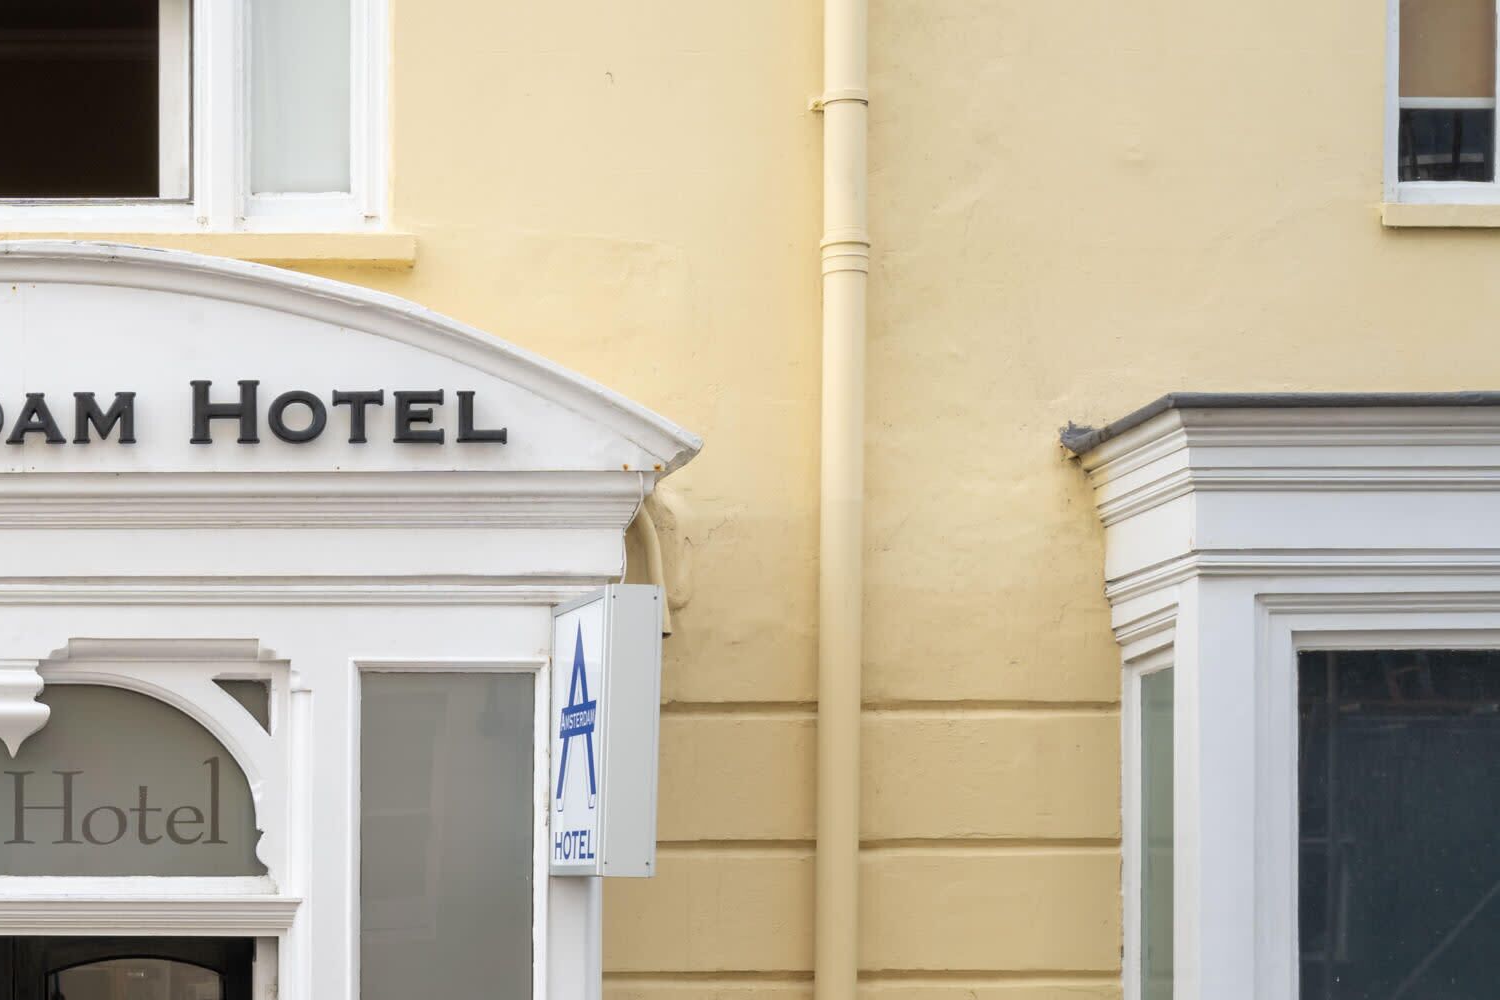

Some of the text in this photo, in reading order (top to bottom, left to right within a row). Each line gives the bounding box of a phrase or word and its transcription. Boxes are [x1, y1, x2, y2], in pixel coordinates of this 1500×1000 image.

[189, 379, 507, 446] HOTEL
[560, 707, 596, 732] AMSTERDAM
[3, 756, 229, 846] Hotel
[554, 830, 595, 861] HOTEL
